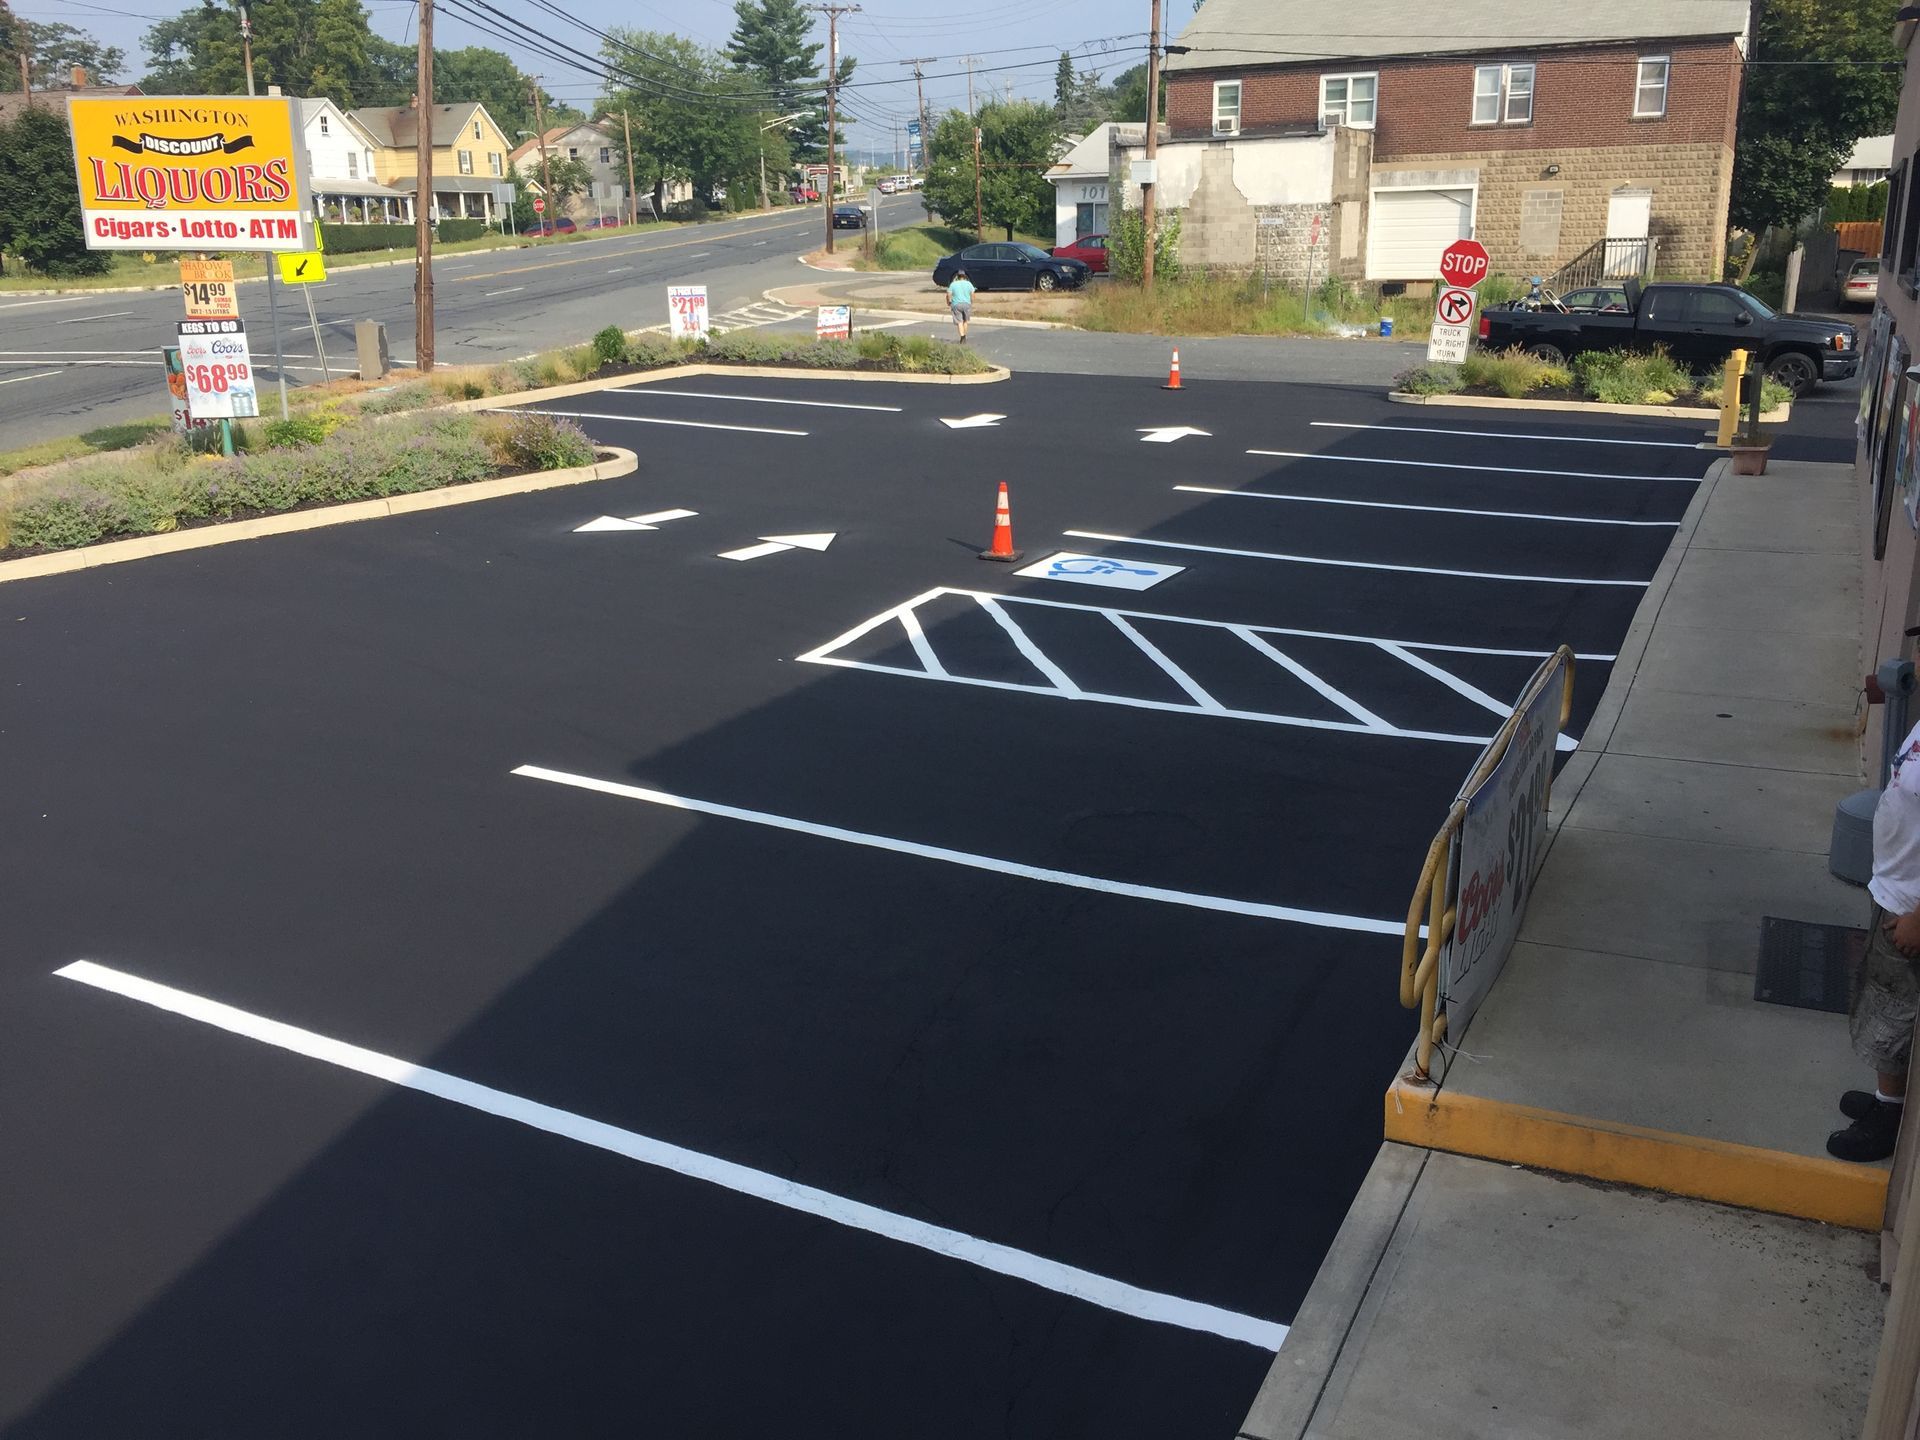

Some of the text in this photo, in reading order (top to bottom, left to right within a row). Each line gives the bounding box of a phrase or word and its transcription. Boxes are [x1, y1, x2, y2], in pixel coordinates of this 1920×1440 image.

[114, 109, 249, 128] WASHINGTON
[145, 135, 220, 154] DISCOUNT
[89, 157, 292, 208] LIQUORS
[1081, 186, 1106, 199] 101
[94, 217, 297, 239] Cigars Lotto ATM
[1443, 253, 1486, 275] STOP
[182, 321, 238, 334] KEGS TO GO
[1440, 328, 1461, 337] TRUCK
[211, 340, 244, 354] Coors
[1433, 339, 1466, 348] NO RIGHT
[1437, 350, 1456, 358] TURN
